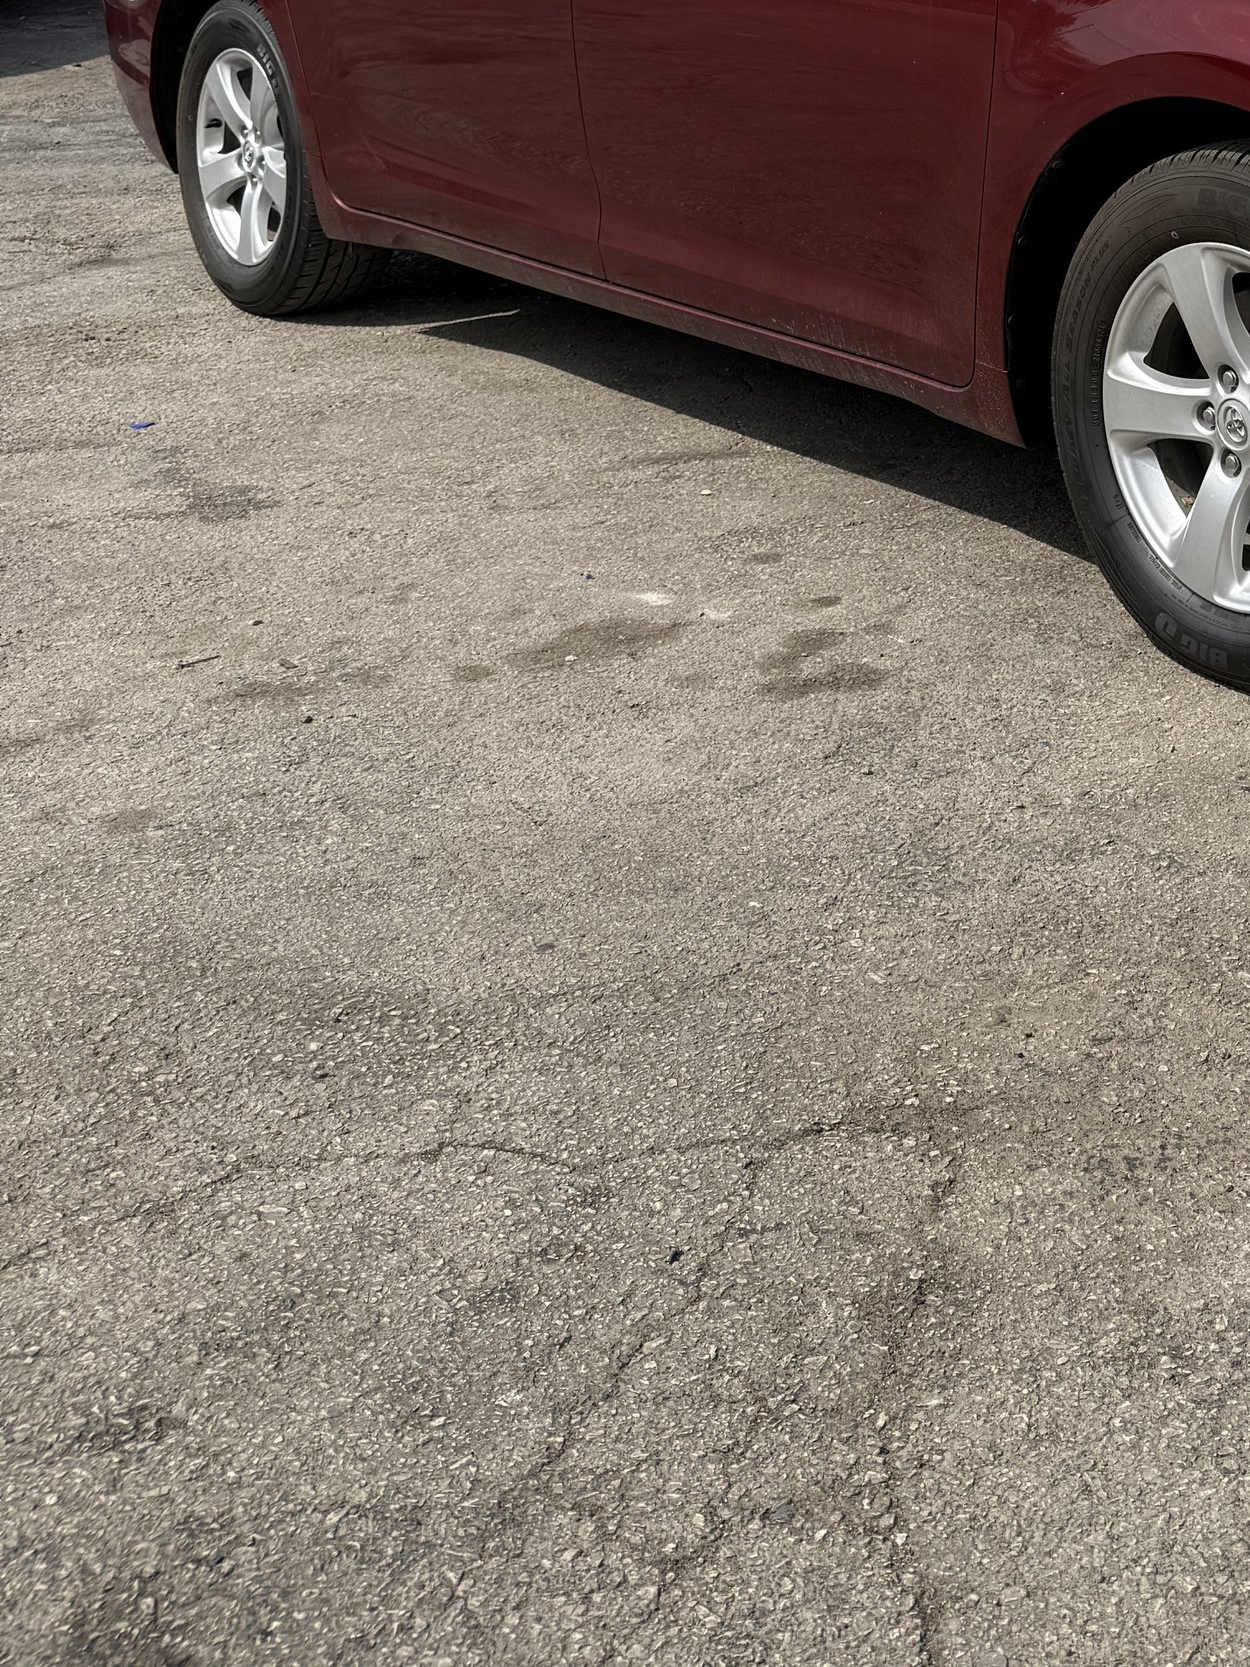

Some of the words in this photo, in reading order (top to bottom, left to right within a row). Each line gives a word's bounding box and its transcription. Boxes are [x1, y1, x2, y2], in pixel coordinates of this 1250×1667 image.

[257, 44, 275, 76] BIG
[1198, 188, 1248, 216] BIG
[1066, 272, 1092, 354] SEASON
[1091, 239, 1109, 272] PLUS
[1181, 633, 1228, 669] BIG
